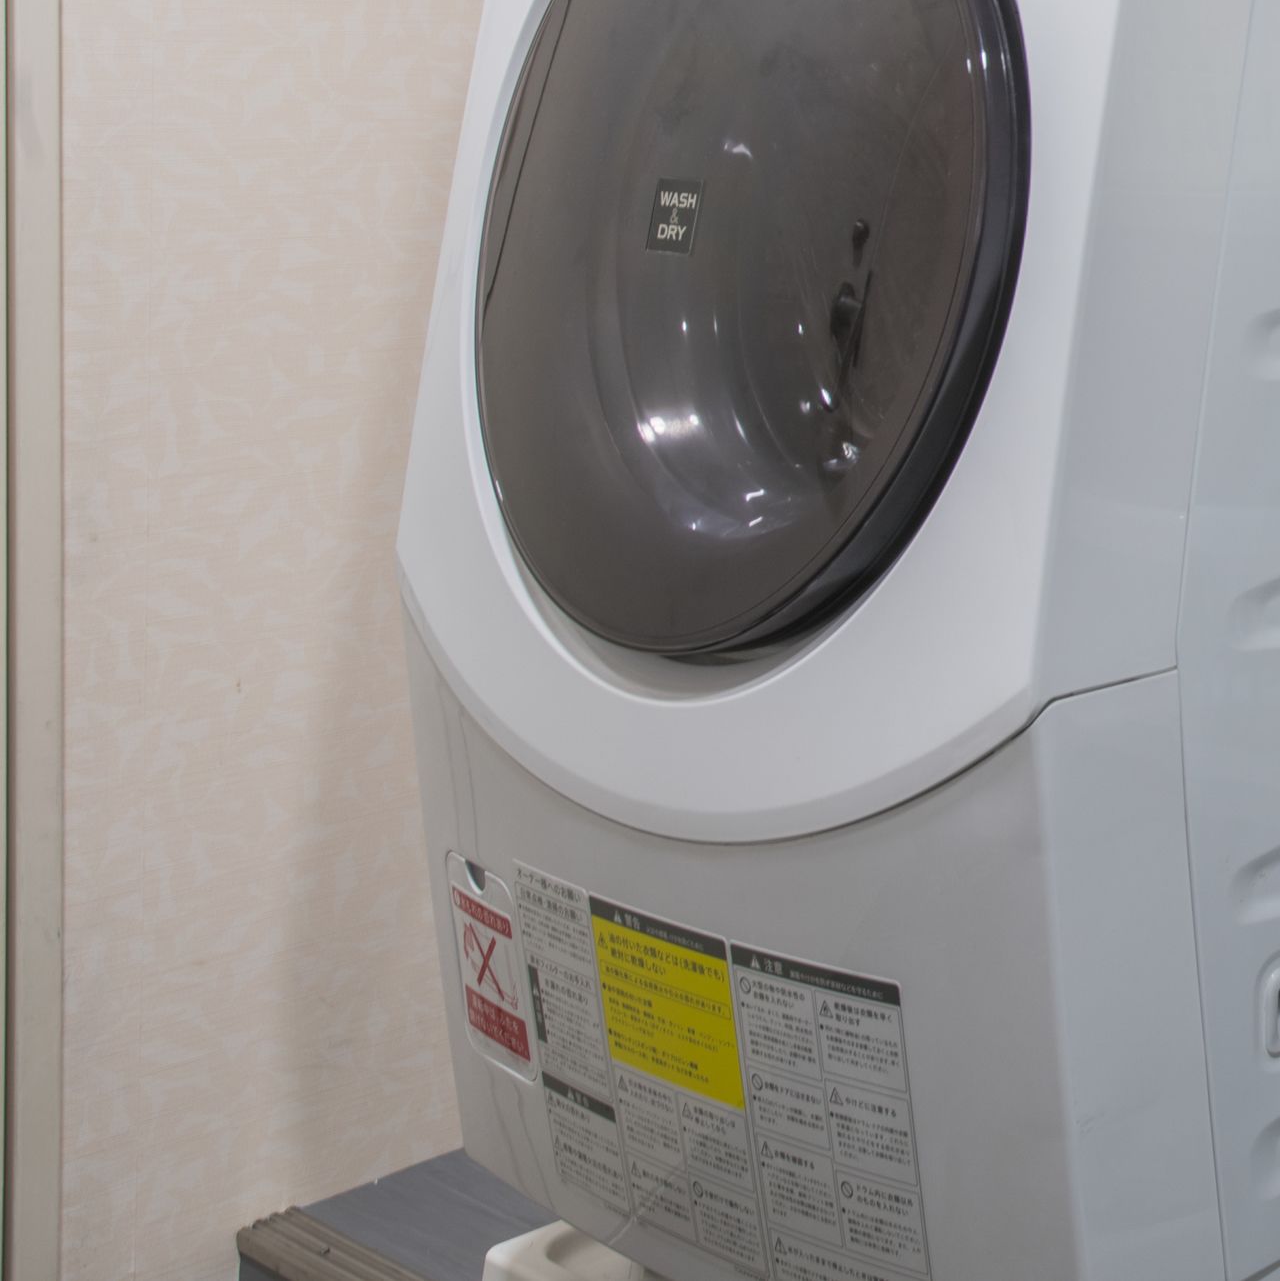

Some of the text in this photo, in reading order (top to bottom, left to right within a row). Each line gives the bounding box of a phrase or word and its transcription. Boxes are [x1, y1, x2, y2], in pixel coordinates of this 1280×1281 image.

[660, 190, 697, 209] WASH
[669, 207, 679, 225] &
[657, 223, 687, 241] DRY
[762, 956, 784, 975] 注意
